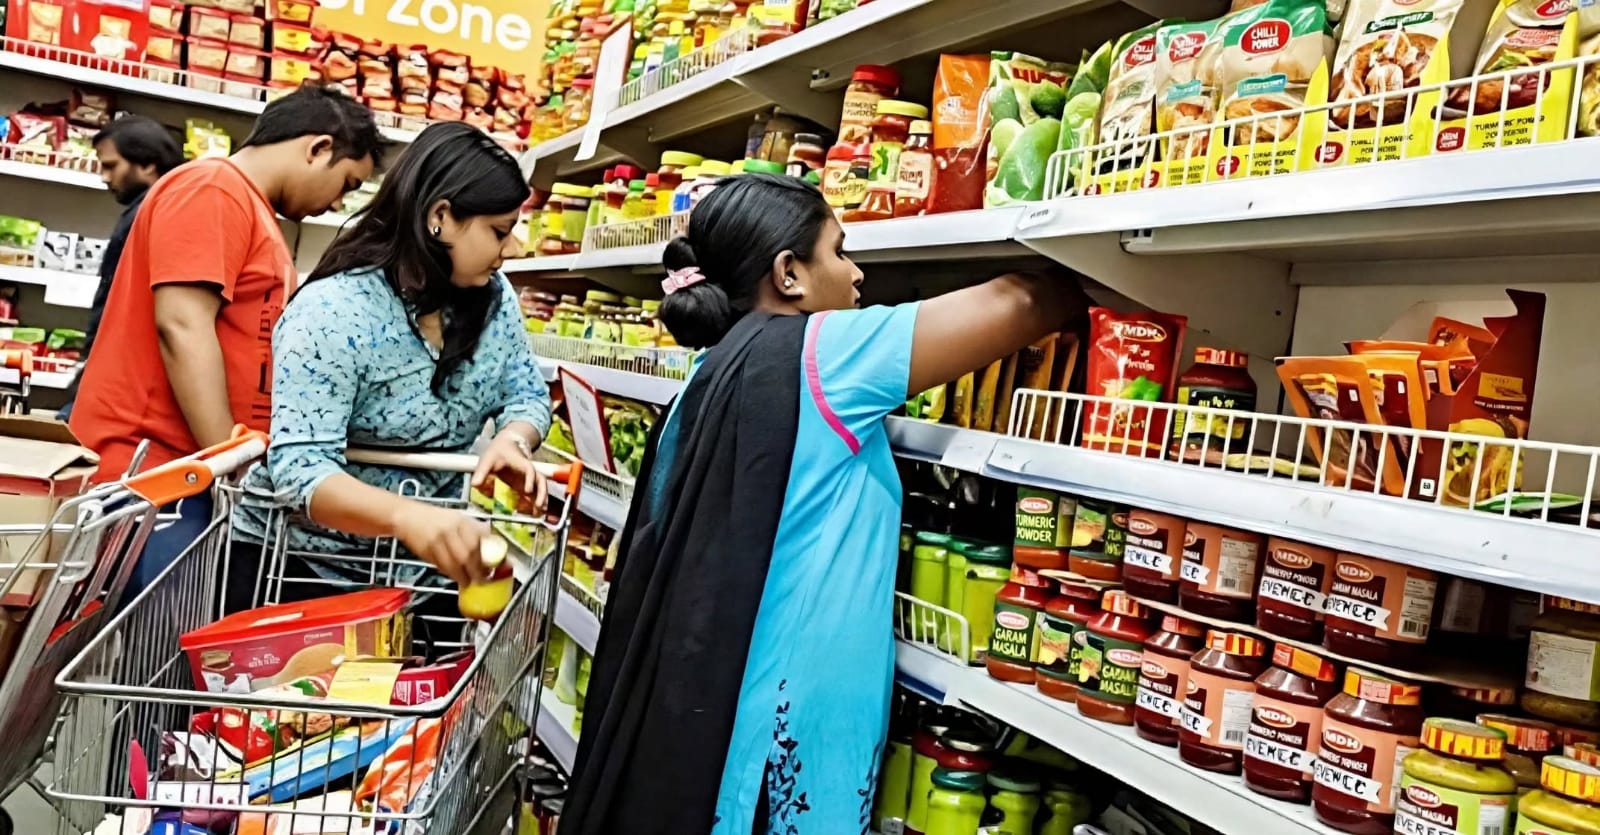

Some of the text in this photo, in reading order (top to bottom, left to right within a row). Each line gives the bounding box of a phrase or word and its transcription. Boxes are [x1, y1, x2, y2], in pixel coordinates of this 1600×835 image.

[386, 0, 532, 52] zone
[1252, 36, 1280, 49] POWER
[1015, 513, 1056, 529] TURMERIC
[1016, 526, 1052, 543] POWDER
[1276, 551, 1309, 566] MDH
[1338, 565, 1370, 579] MDH
[994, 628, 1028, 645] GARAM
[992, 639, 1027, 658] MASALA
[1258, 708, 1294, 726] MDH
[1323, 728, 1360, 750] MDH
